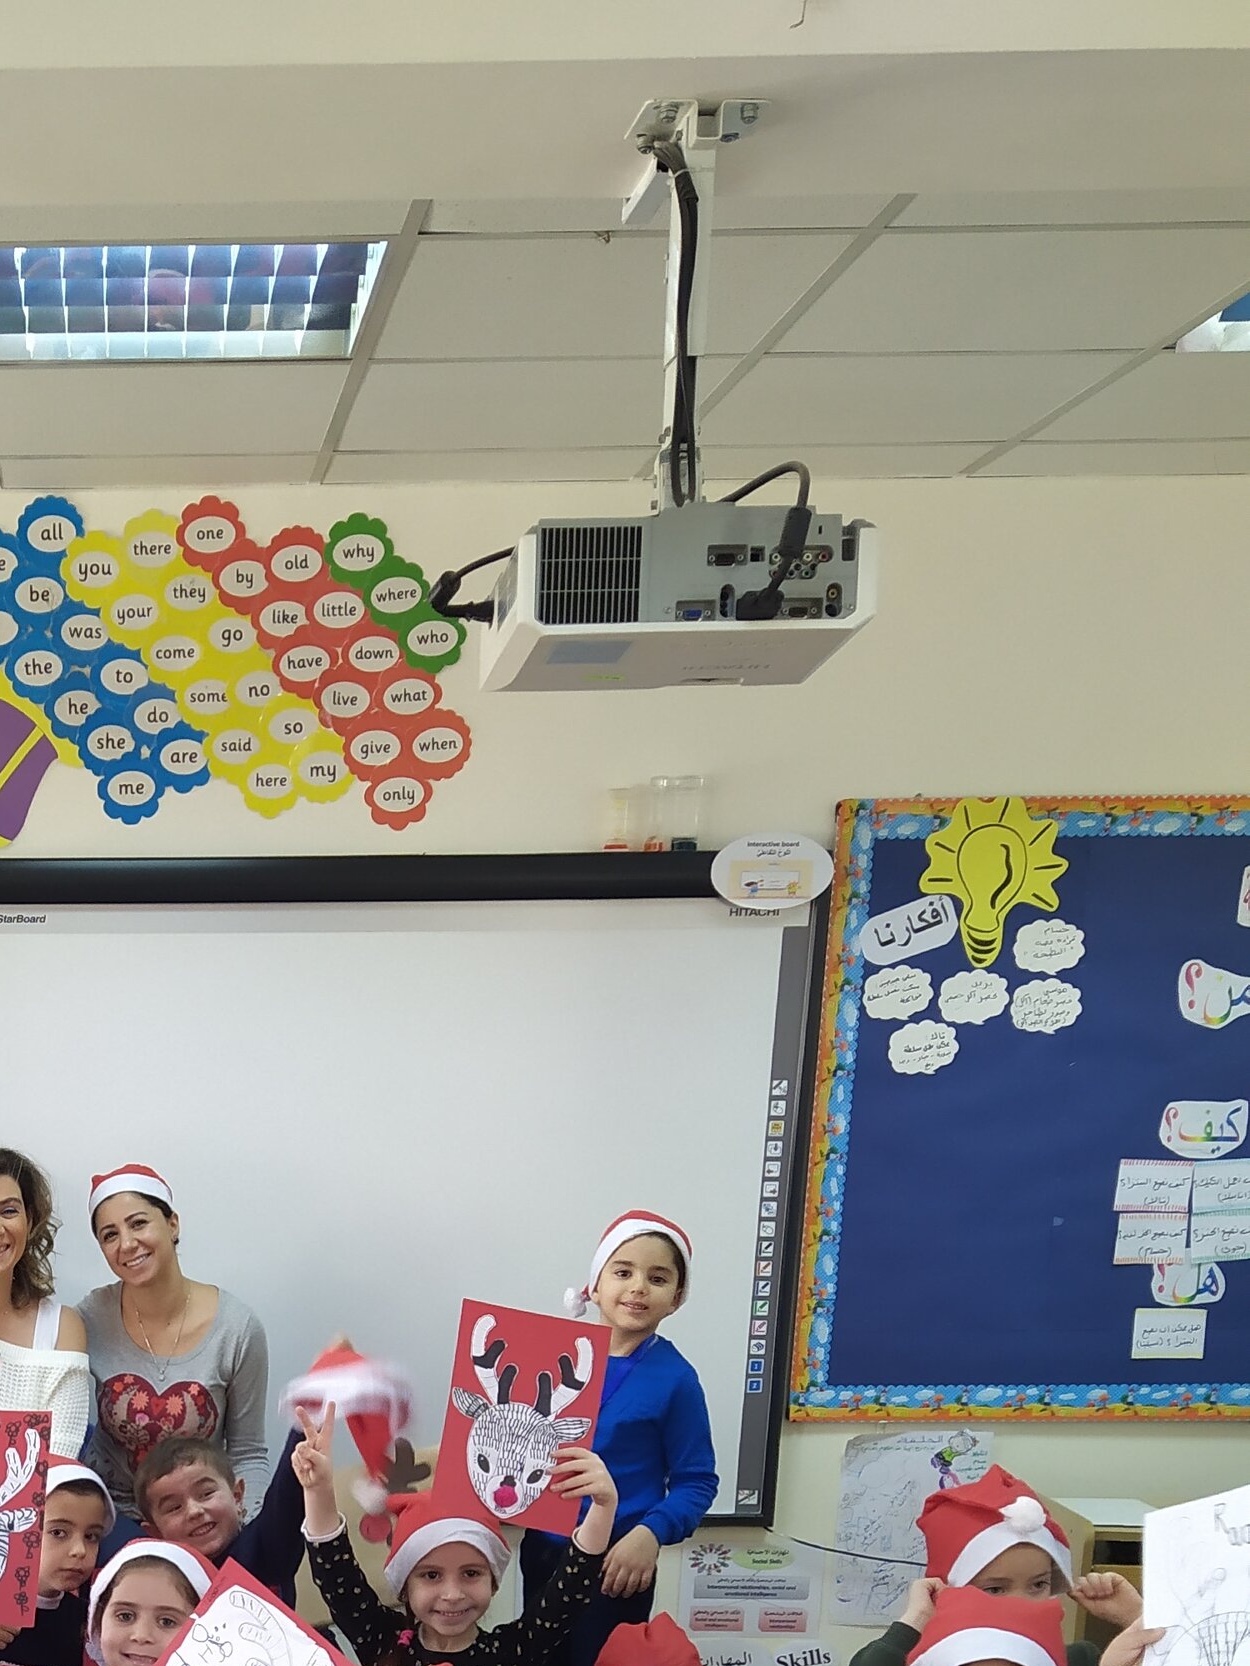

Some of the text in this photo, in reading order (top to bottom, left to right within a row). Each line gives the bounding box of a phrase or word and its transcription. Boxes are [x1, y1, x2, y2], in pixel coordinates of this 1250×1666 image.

[40, 522, 64, 541] all
[196, 529, 224, 541] one
[133, 540, 172, 556] there
[342, 543, 375, 563] why
[284, 554, 309, 570] old
[78, 563, 112, 582] you
[236, 568, 254, 589] by
[29, 584, 50, 603] be
[173, 583, 206, 604] they
[374, 588, 418, 602] where
[117, 607, 152, 626] your
[272, 609, 299, 624] like
[321, 601, 357, 617] little
[68, 627, 102, 639] was
[221, 629, 243, 648] go
[416, 629, 449, 645] who
[155, 648, 195, 660] come
[355, 645, 394, 660] down
[24, 658, 53, 676] the
[287, 655, 323, 670] have
[115, 669, 133, 684] to
[190, 692, 226, 703] some
[248, 684, 270, 698] no
[332, 690, 358, 706] live
[390, 688, 427, 703] what
[67, 696, 89, 716] he
[147, 706, 169, 723] do
[284, 722, 303, 735] so
[96, 732, 126, 750] she
[221, 737, 252, 752] said
[418, 737, 458, 752] when
[169, 748, 199, 764] are
[360, 744, 391, 760] give
[256, 773, 287, 787] here
[310, 765, 336, 783] my
[118, 783, 145, 795] me
[382, 786, 415, 806] only
[781, 840, 800, 848] board
[729, 907, 781, 917] HITACHI
[873, 894, 950, 949] أفكارنا
